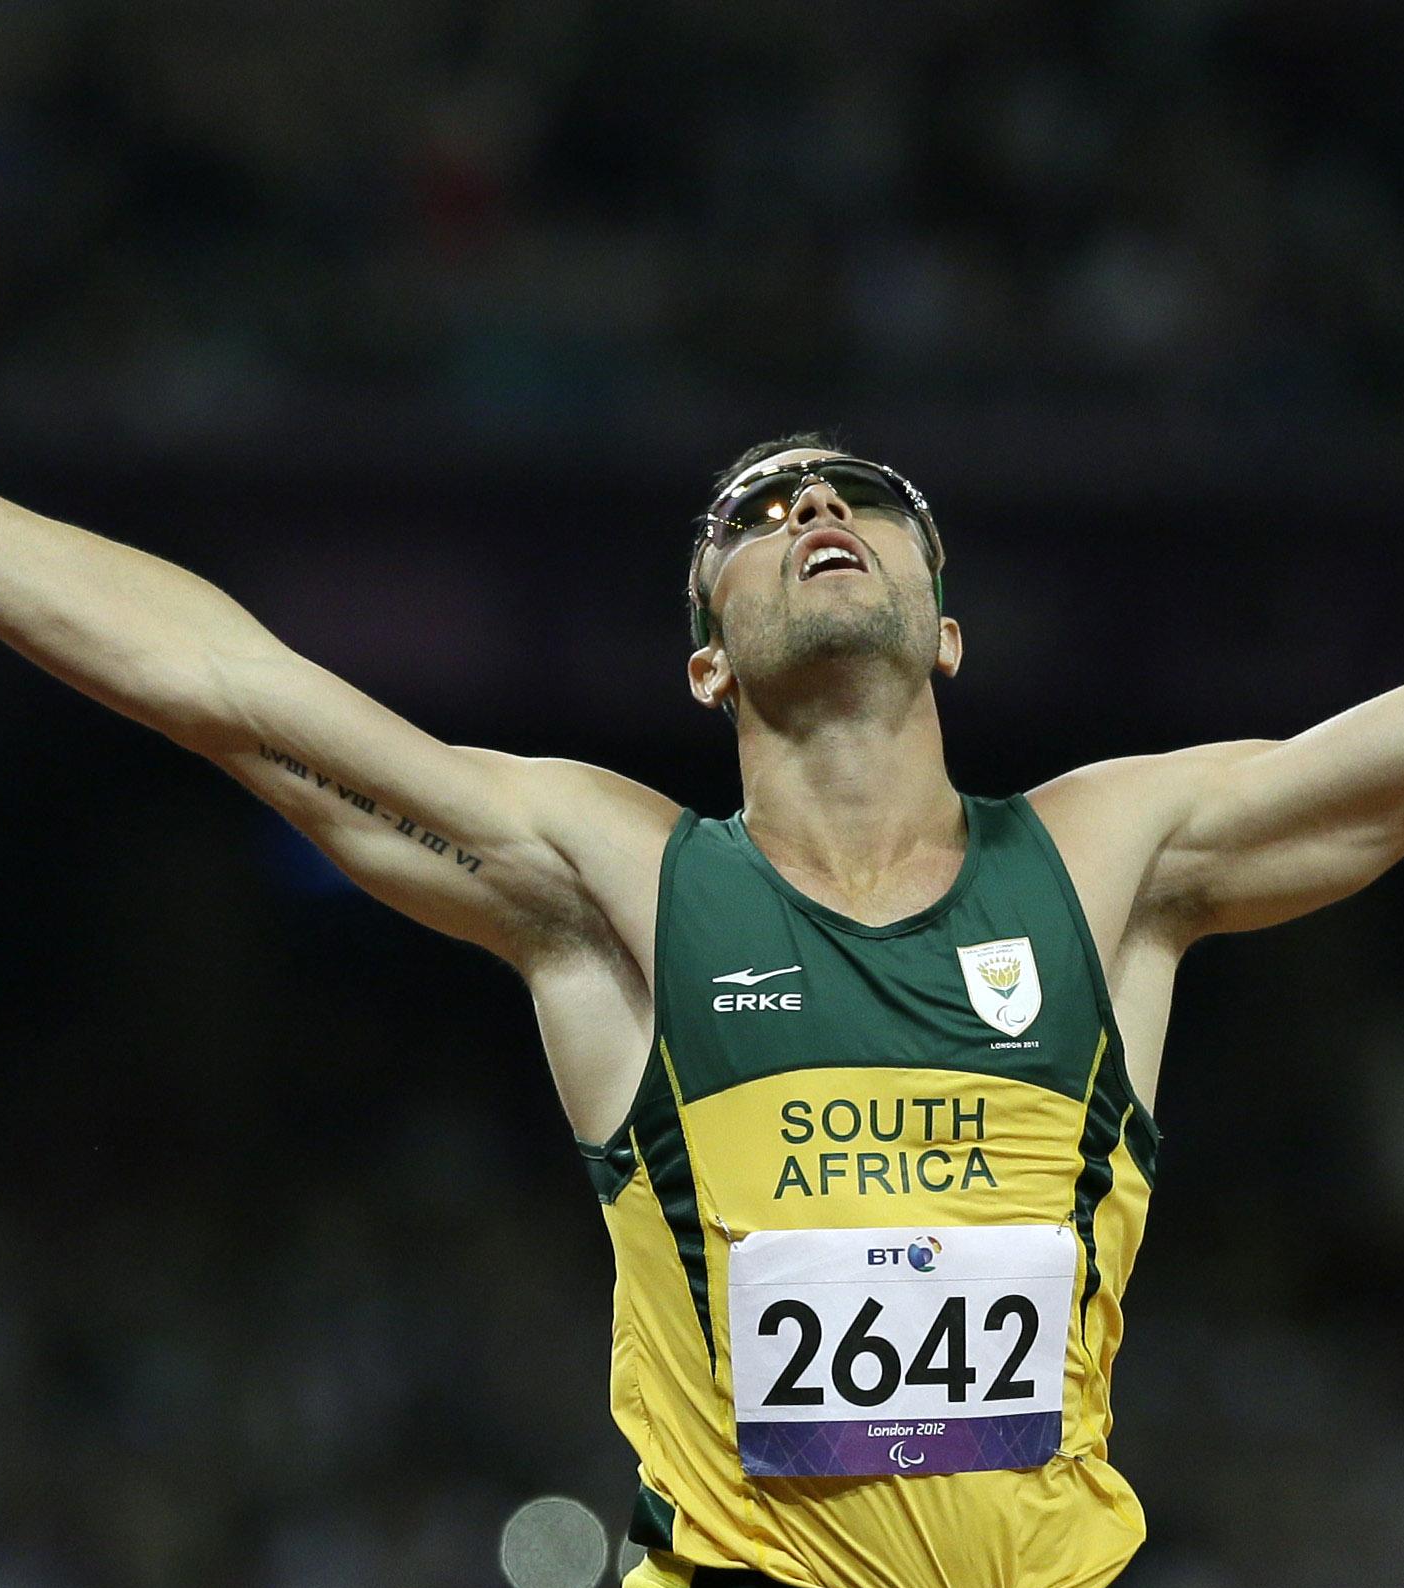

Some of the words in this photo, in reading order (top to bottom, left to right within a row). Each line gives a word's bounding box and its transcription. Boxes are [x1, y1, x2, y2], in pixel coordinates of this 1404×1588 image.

[315, 771, 333, 789] V
[395, 816, 418, 838] II
[419, 831, 451, 857] III
[456, 848, 482, 875] VI
[712, 992, 803, 1013] ERKE
[990, 1042, 1022, 1050] LONDON
[779, 1097, 986, 1145] SOUTH
[772, 1146, 999, 1201] AFRICA
[867, 1248, 906, 1266] BT
[757, 1293, 1040, 1408] 2642
[867, 1422, 914, 1438] London
[915, 1421, 946, 1436] 2012
